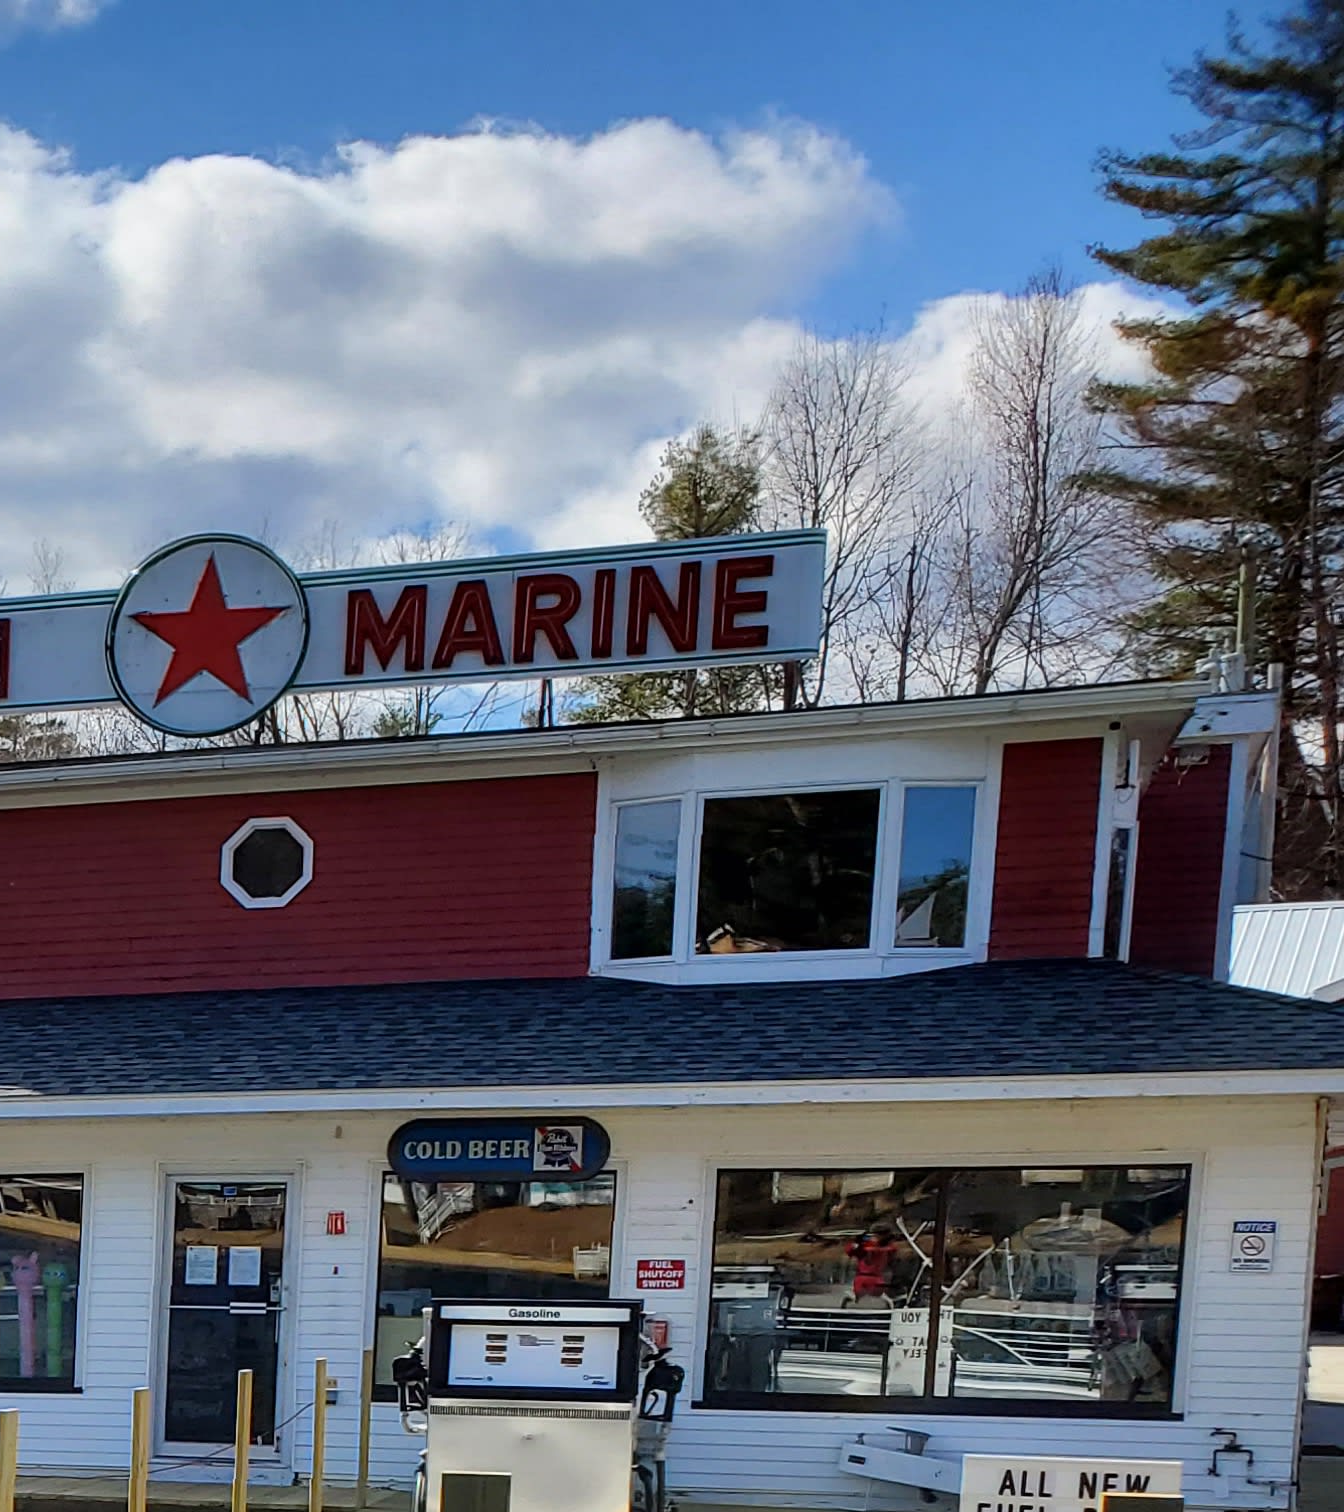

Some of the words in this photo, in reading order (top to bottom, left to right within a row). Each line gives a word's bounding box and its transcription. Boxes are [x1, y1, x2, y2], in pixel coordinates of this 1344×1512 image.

[344, 554, 776, 677] MARINE
[404, 1141, 462, 1160] COLD
[468, 1140, 530, 1159] BEER
[1236, 1223, 1275, 1232] NOTICE
[649, 1260, 673, 1269] FUEL
[638, 1270, 684, 1279] SHUT-OFF
[642, 1279, 679, 1288] SWITCH
[508, 1308, 561, 1319] Gasoline
[998, 1469, 1053, 1498] ALL
[1078, 1471, 1151, 1500] NEW
